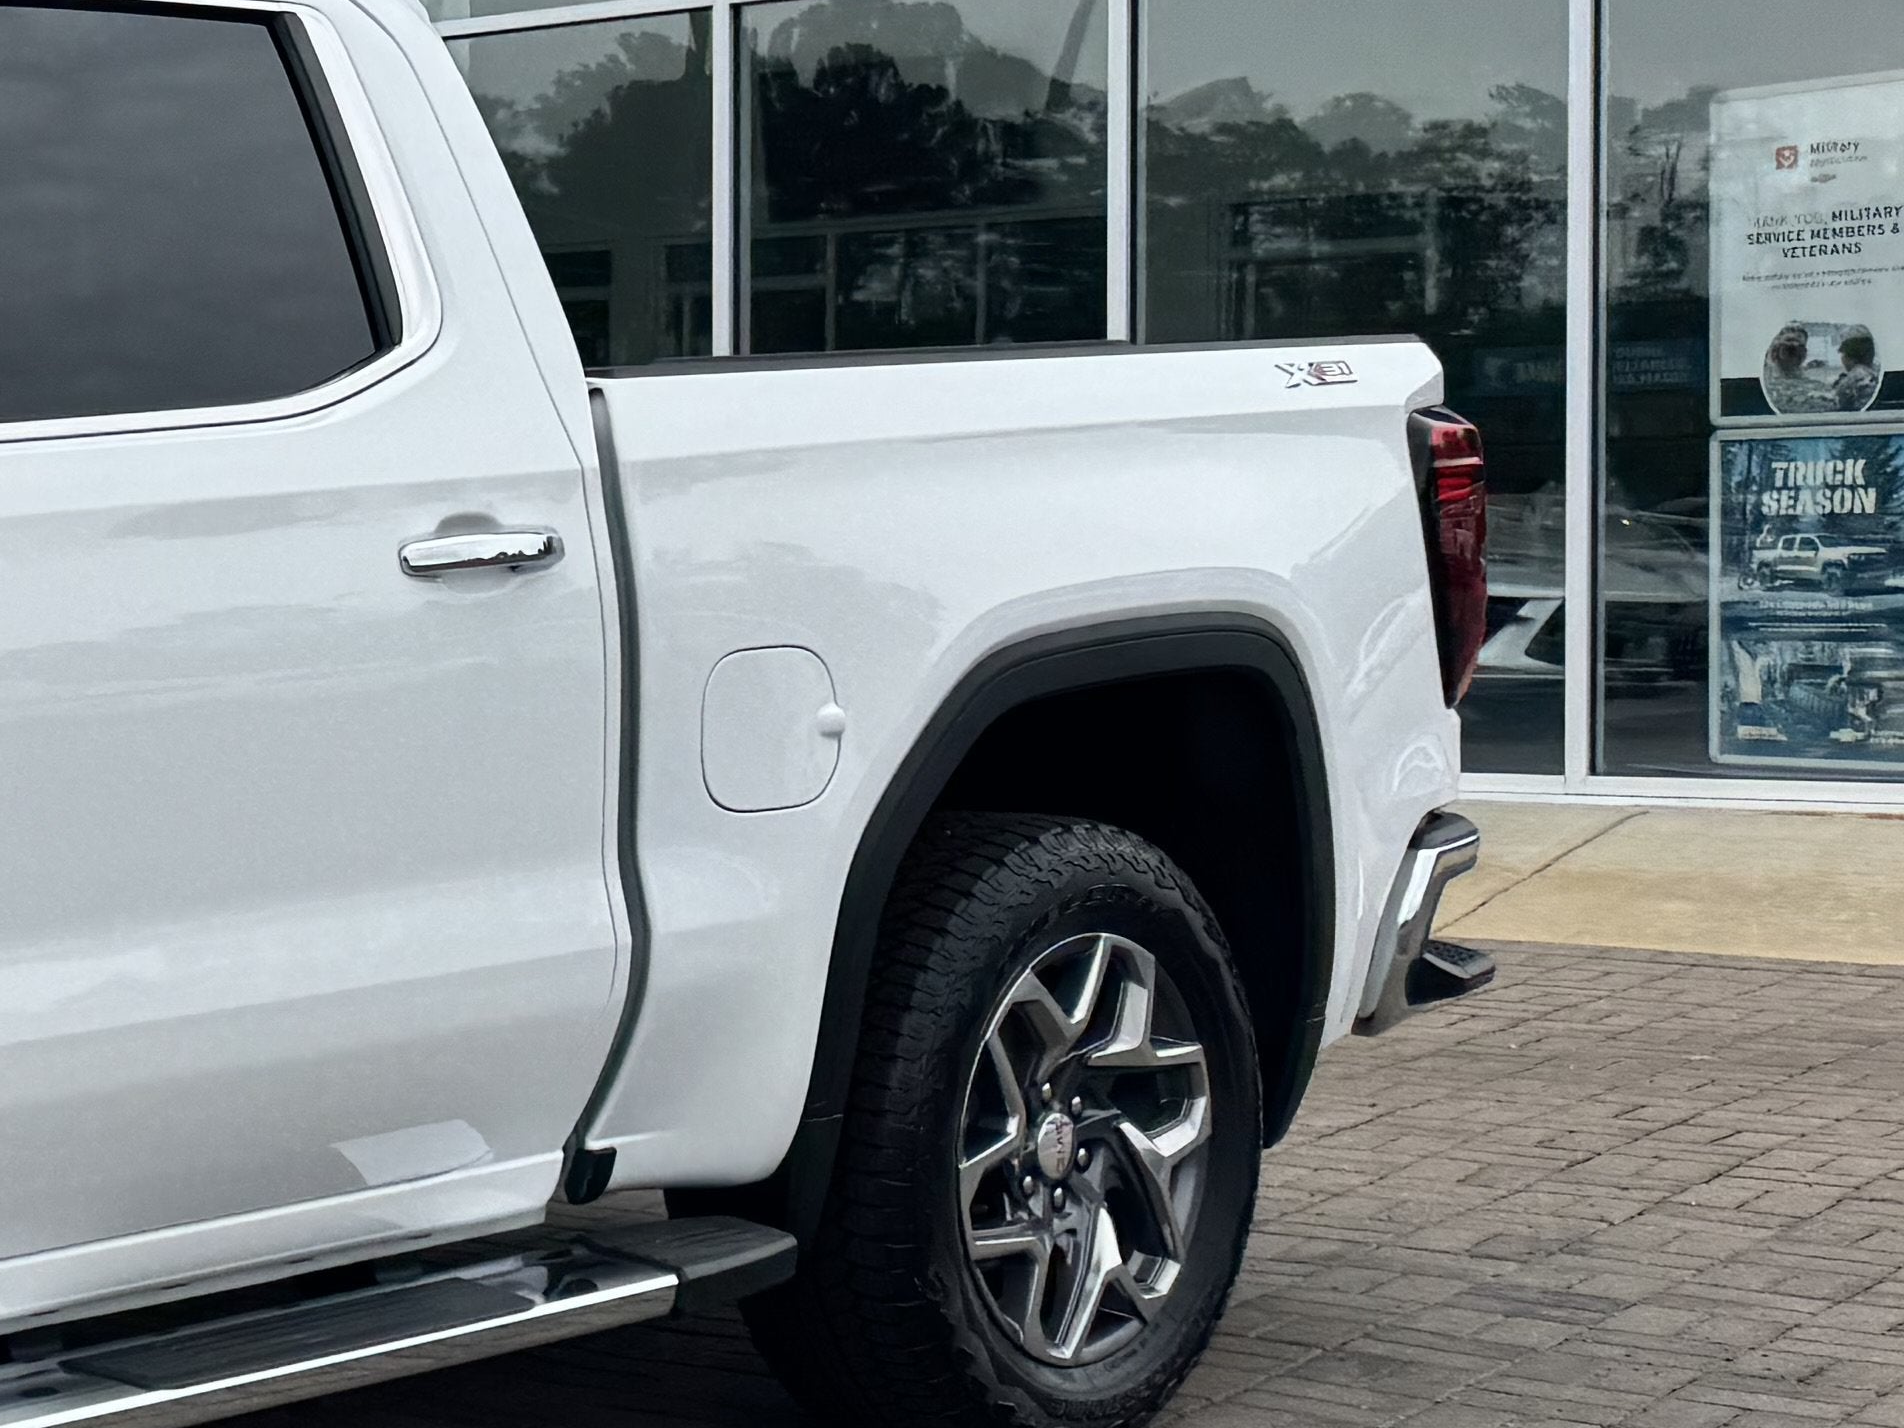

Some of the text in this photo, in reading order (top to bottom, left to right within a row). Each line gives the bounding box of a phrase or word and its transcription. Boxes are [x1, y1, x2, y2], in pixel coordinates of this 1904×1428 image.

[1831, 205, 1903, 222] MILITARY
[1746, 229, 1806, 245] SERVICE
[1810, 224, 1886, 240] MEMBERS
[1782, 241, 1863, 259] VETERANS
[1770, 459, 1867, 488] TRUCK
[1760, 487, 1876, 516] SEASON
